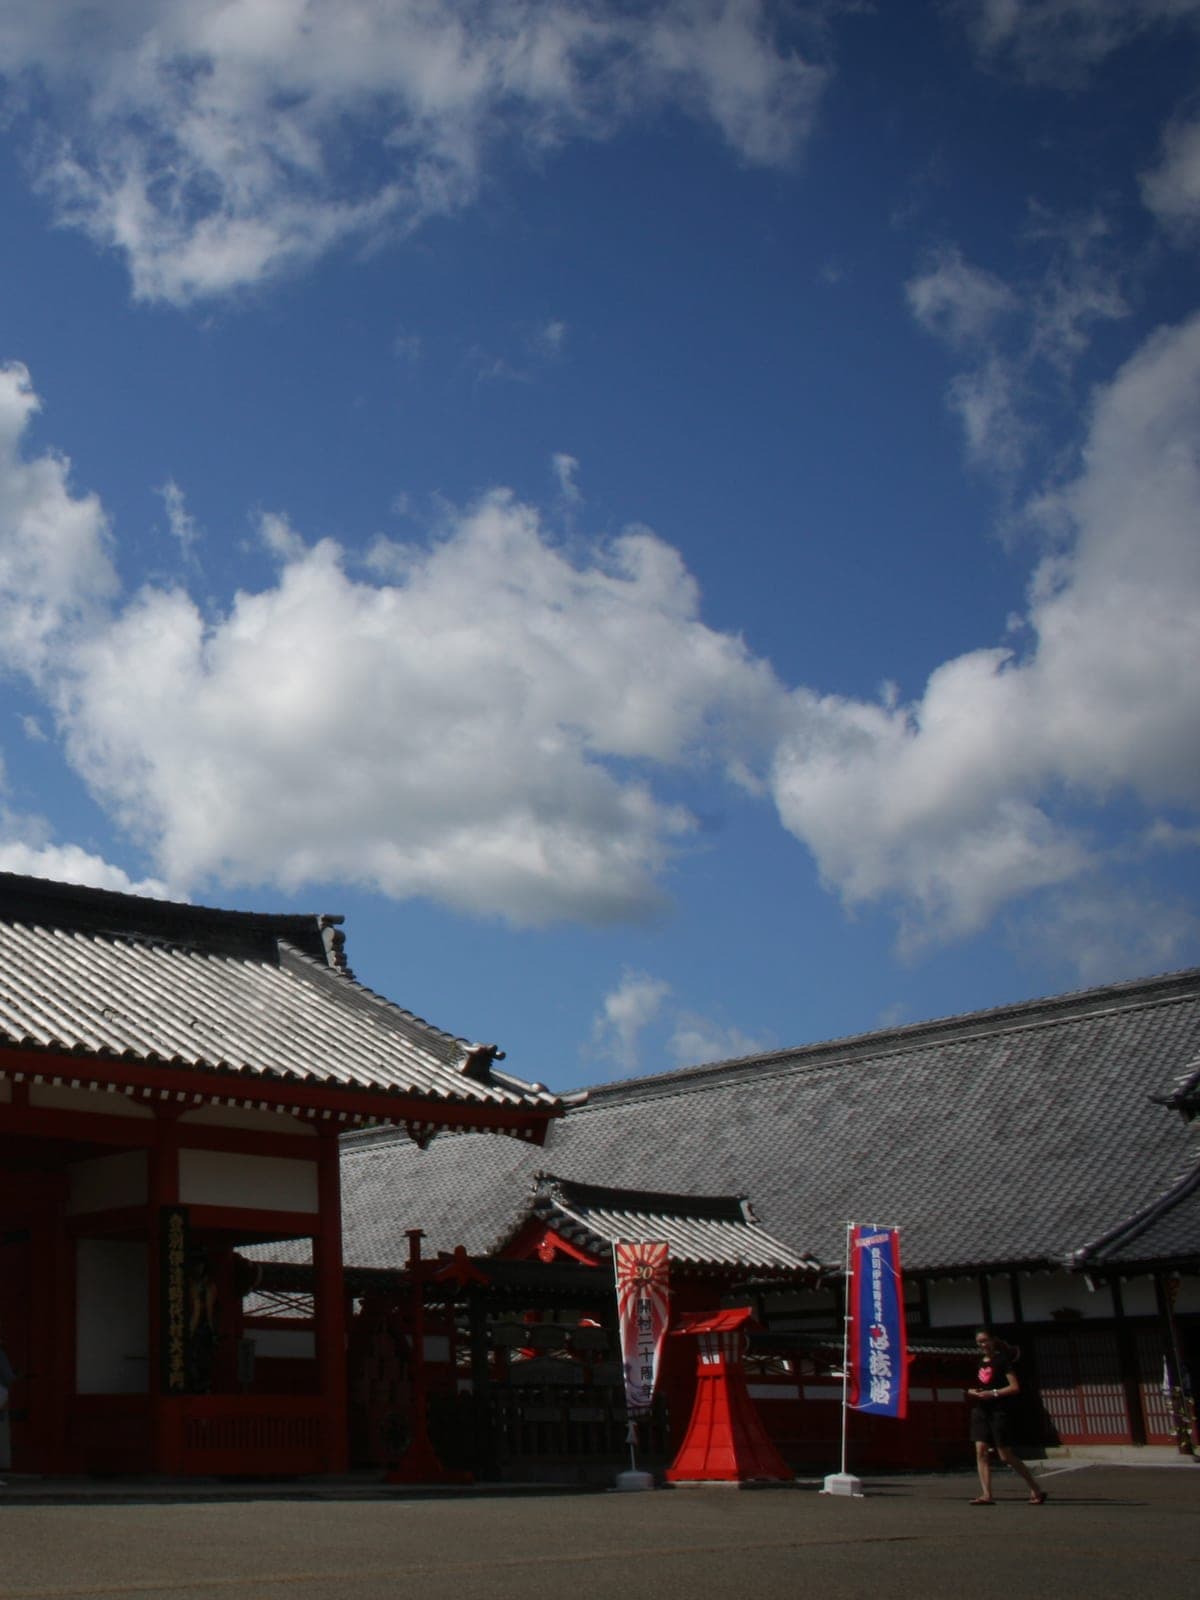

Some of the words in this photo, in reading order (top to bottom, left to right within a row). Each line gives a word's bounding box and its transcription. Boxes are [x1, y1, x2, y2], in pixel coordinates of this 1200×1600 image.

[634, 1266, 653, 1279] 20
[638, 1299, 654, 1398] 開村二十周年
